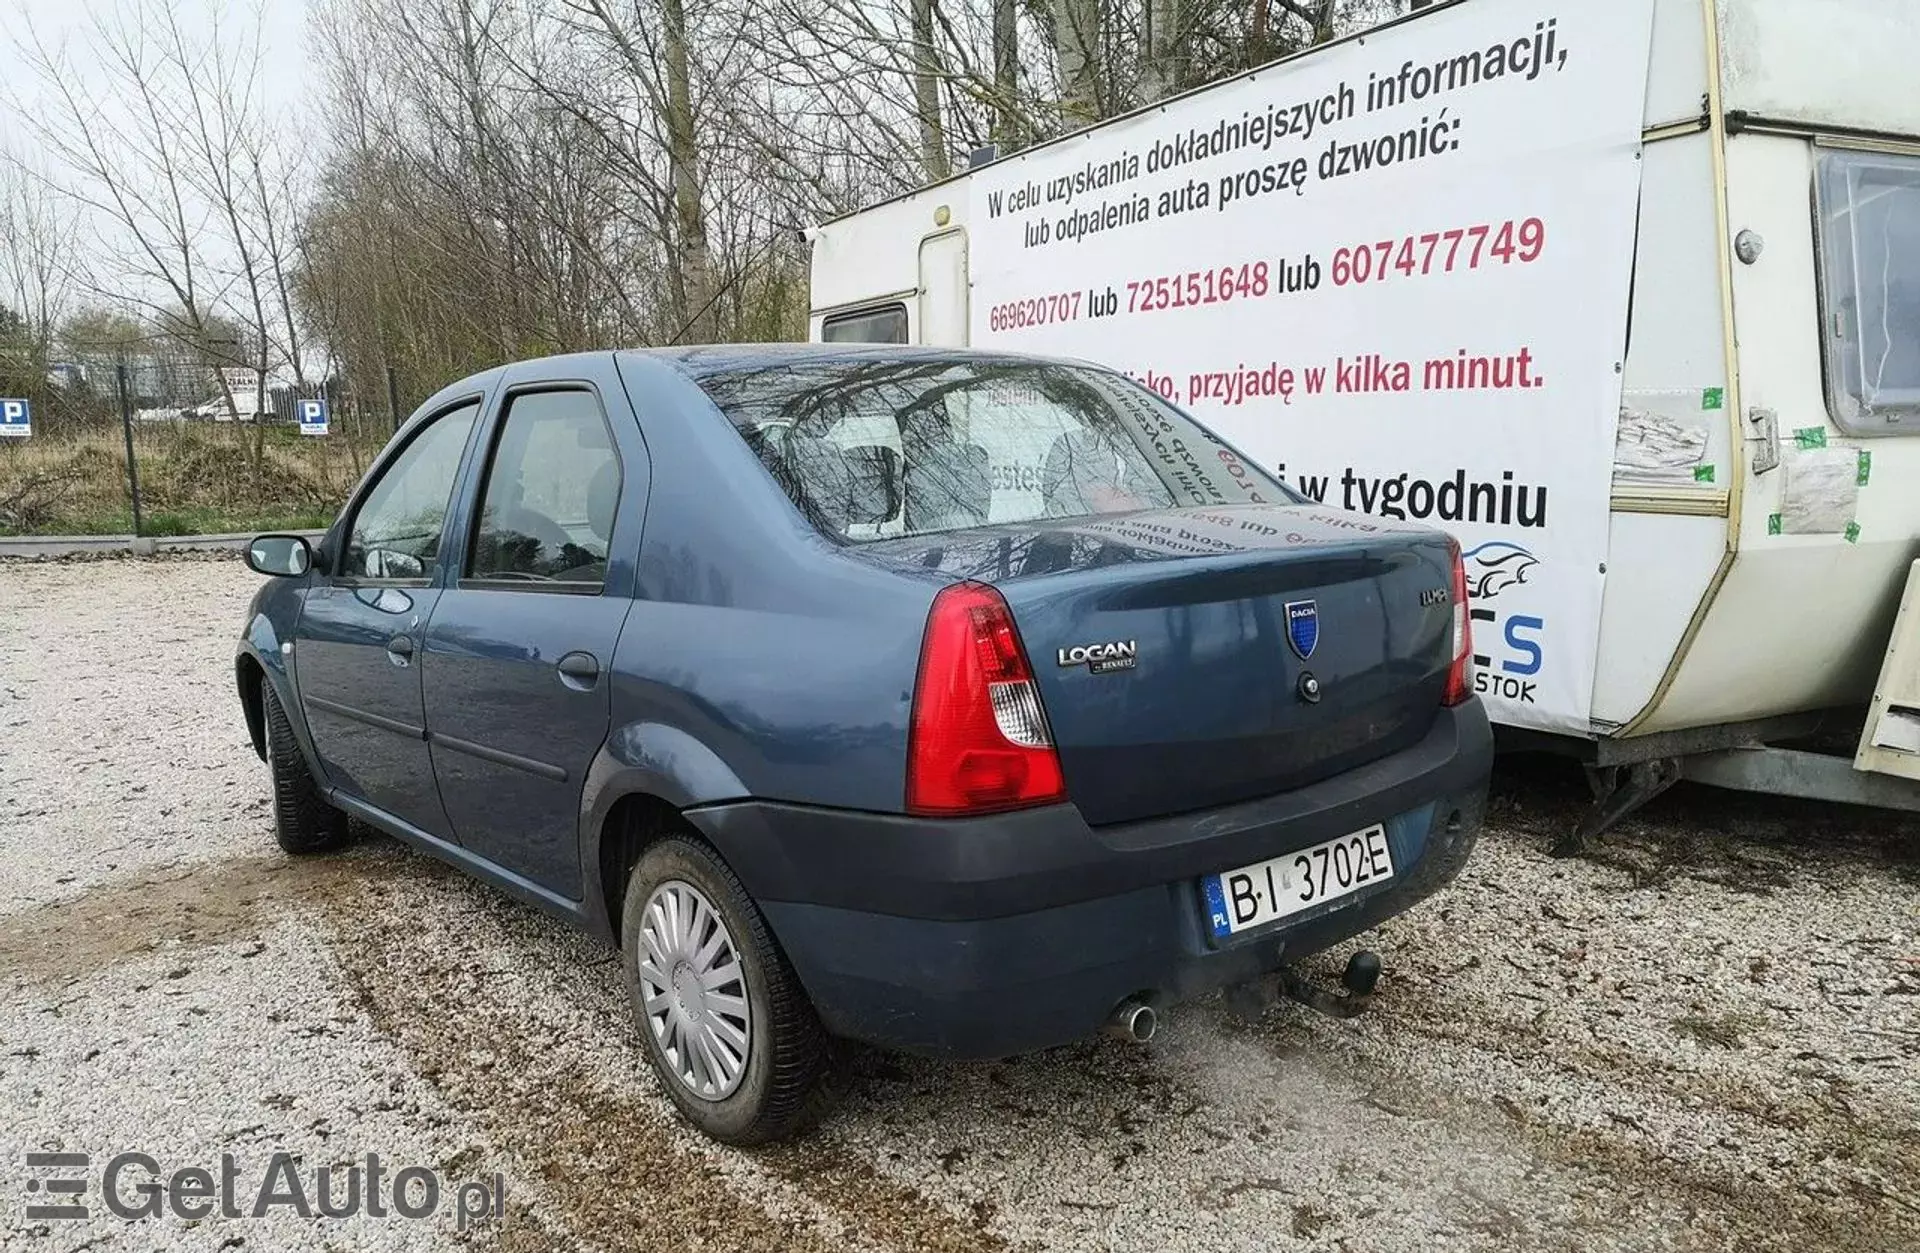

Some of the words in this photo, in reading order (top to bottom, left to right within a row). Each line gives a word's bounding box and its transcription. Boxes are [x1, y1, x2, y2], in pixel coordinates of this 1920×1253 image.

[988, 190, 1003, 219] W
[1008, 181, 1041, 214] celu
[1046, 151, 1139, 204] uzyskania
[1146, 81, 1354, 174] dokładniejszych
[1366, 18, 1568, 112] informacji,
[1024, 221, 1050, 248] lub
[1055, 193, 1149, 243] odpalenia
[1157, 179, 1210, 218] auta
[1219, 157, 1308, 212] proszę
[1318, 107, 1460, 180] dzwonić:
[990, 291, 1082, 332] 669620707
[1088, 287, 1118, 318] lub
[1127, 261, 1269, 313] 725151648
[1278, 254, 1321, 293] lub
[1331, 217, 1545, 286] 607477749
[1189, 361, 1294, 406] przyjadę
[1304, 367, 1326, 394] w
[1335, 354, 1410, 393] kilka
[1423, 346, 1544, 391] minut.
[1300, 476, 1329, 502] w
[1341, 467, 1548, 528] tygodniu
[1291, 608, 1316, 618] DACIA
[1058, 640, 1136, 666] LOGAN
[1294, 830, 1389, 901] 3702E
[1212, 914, 1229, 928] PL
